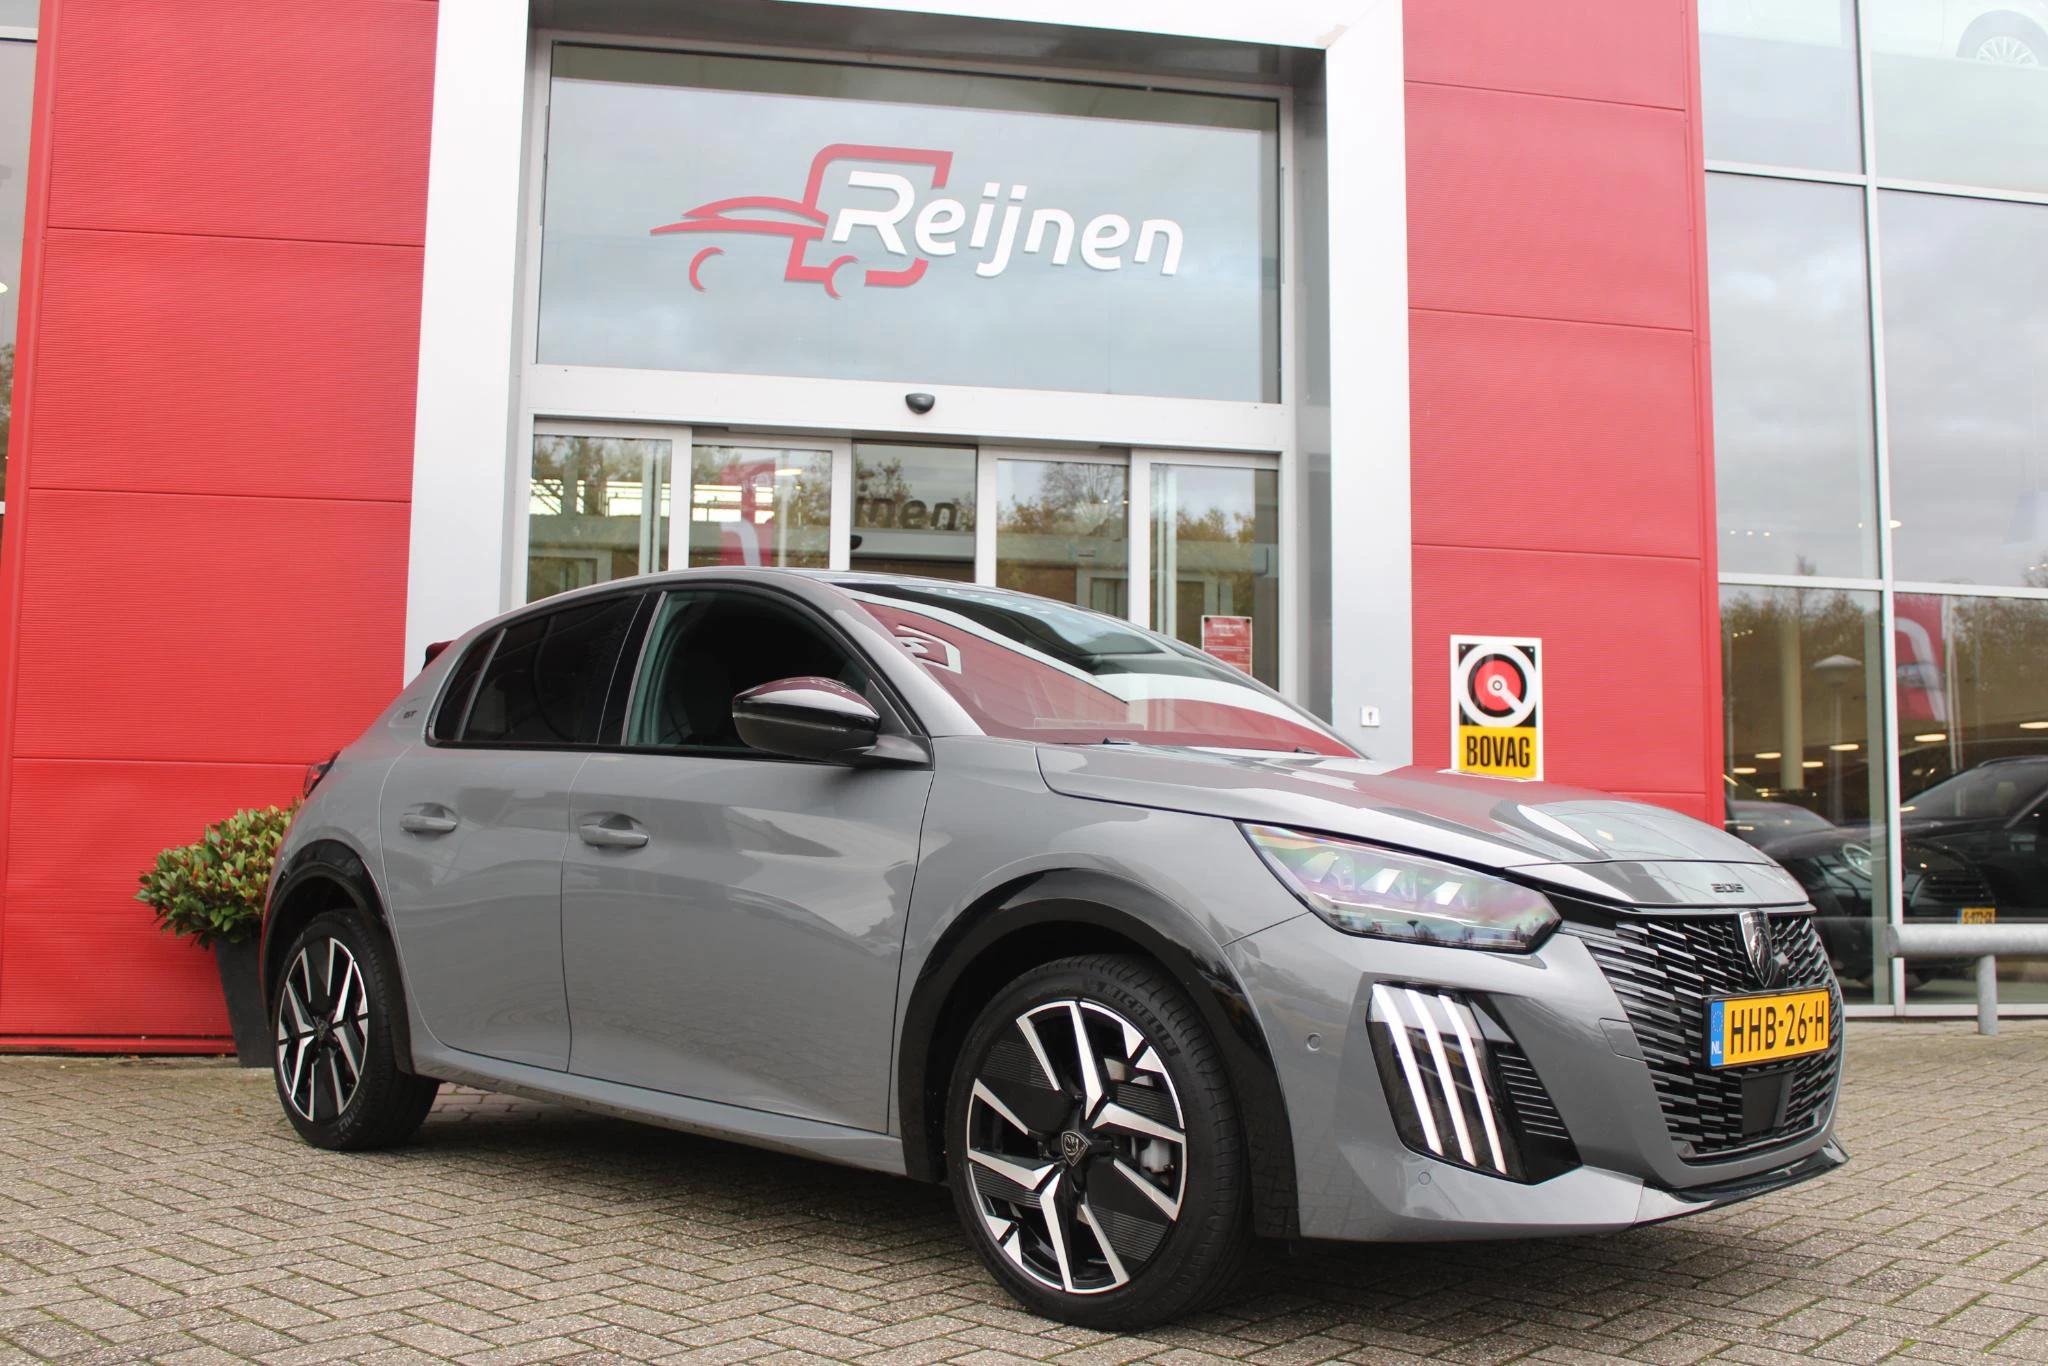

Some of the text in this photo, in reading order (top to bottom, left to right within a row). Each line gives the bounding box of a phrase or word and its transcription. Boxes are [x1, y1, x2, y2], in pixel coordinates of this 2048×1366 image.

[831, 170, 1184, 278] Reijnen
[1466, 735, 1531, 768] BOVAG
[1711, 883, 1744, 893] 208
[1104, 983, 1178, 1054] MICHELIN
[1730, 1000, 1825, 1056] HHB-26-H
[1711, 1040, 1722, 1054] NL
